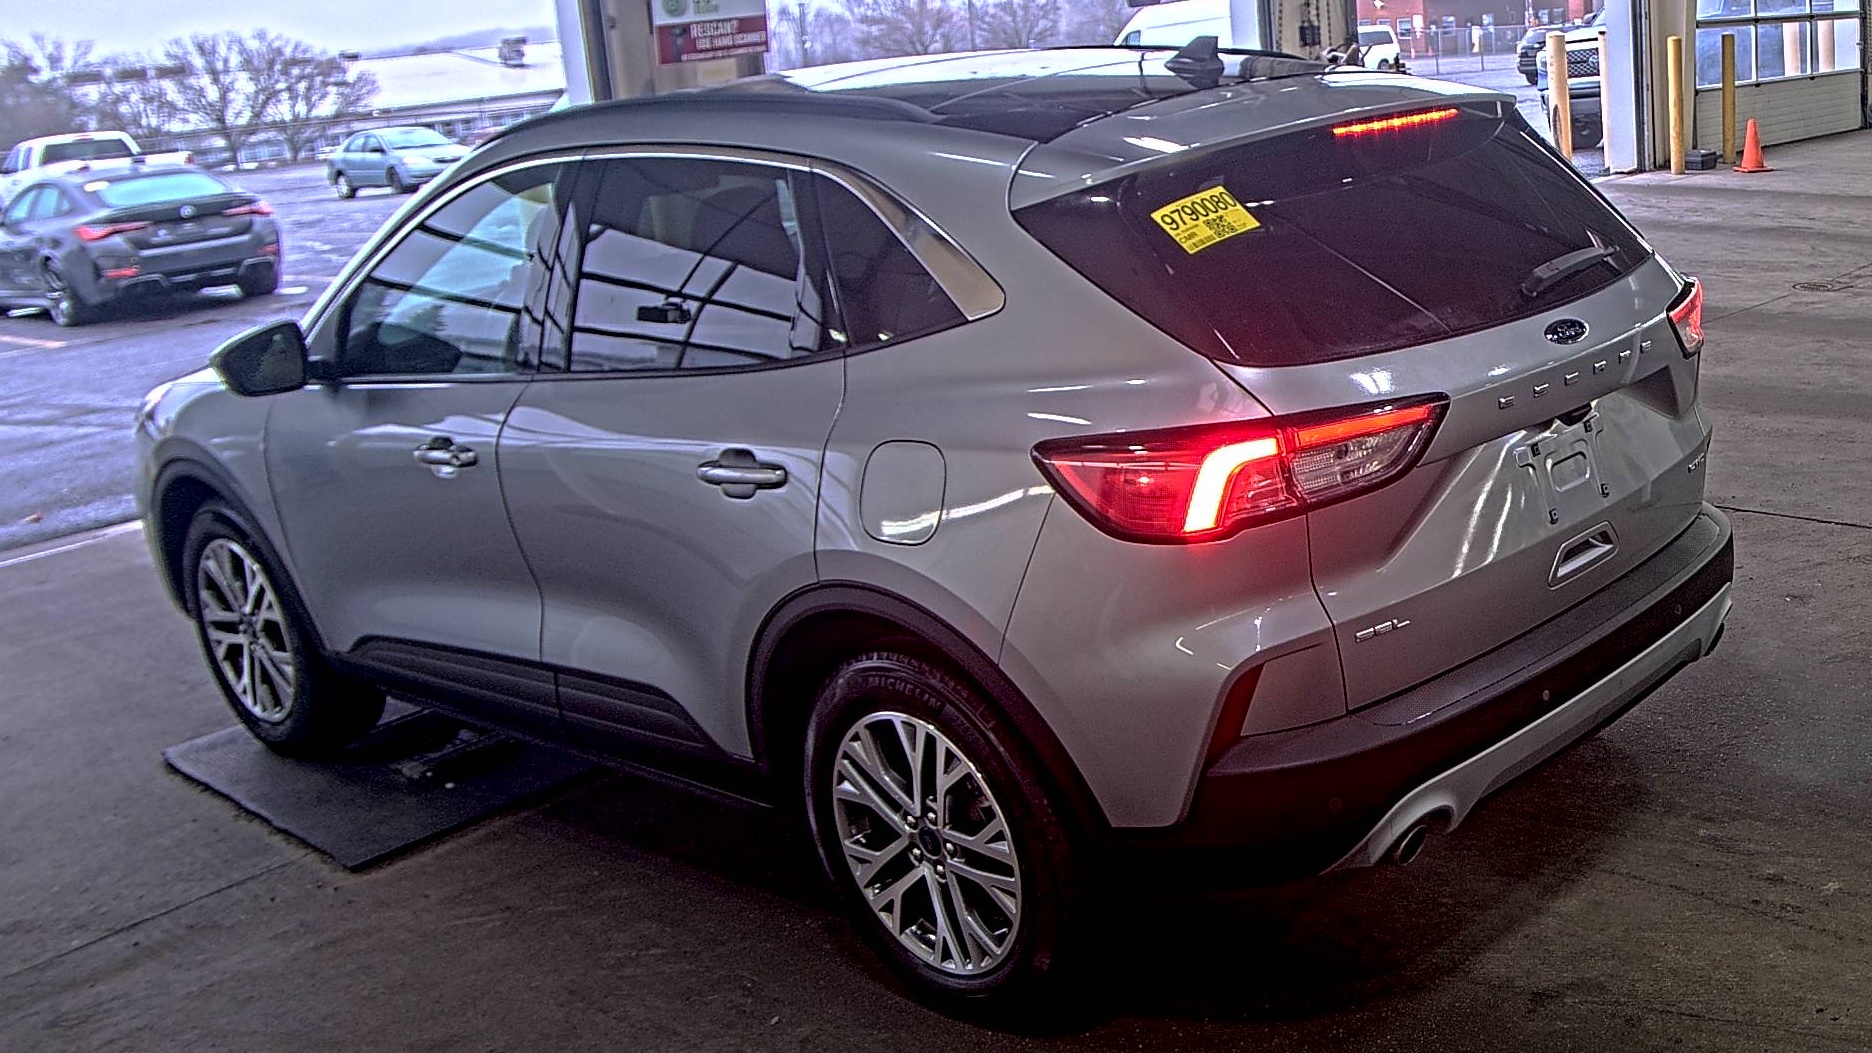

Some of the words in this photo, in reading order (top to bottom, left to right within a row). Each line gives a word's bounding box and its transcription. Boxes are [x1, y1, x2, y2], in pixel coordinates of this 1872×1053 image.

[1160, 191, 1237, 231] 9790080
[1499, 341, 1651, 409] ESCAPE
[1355, 619, 1411, 643] SEL
[868, 676, 941, 709] MICHELIN
